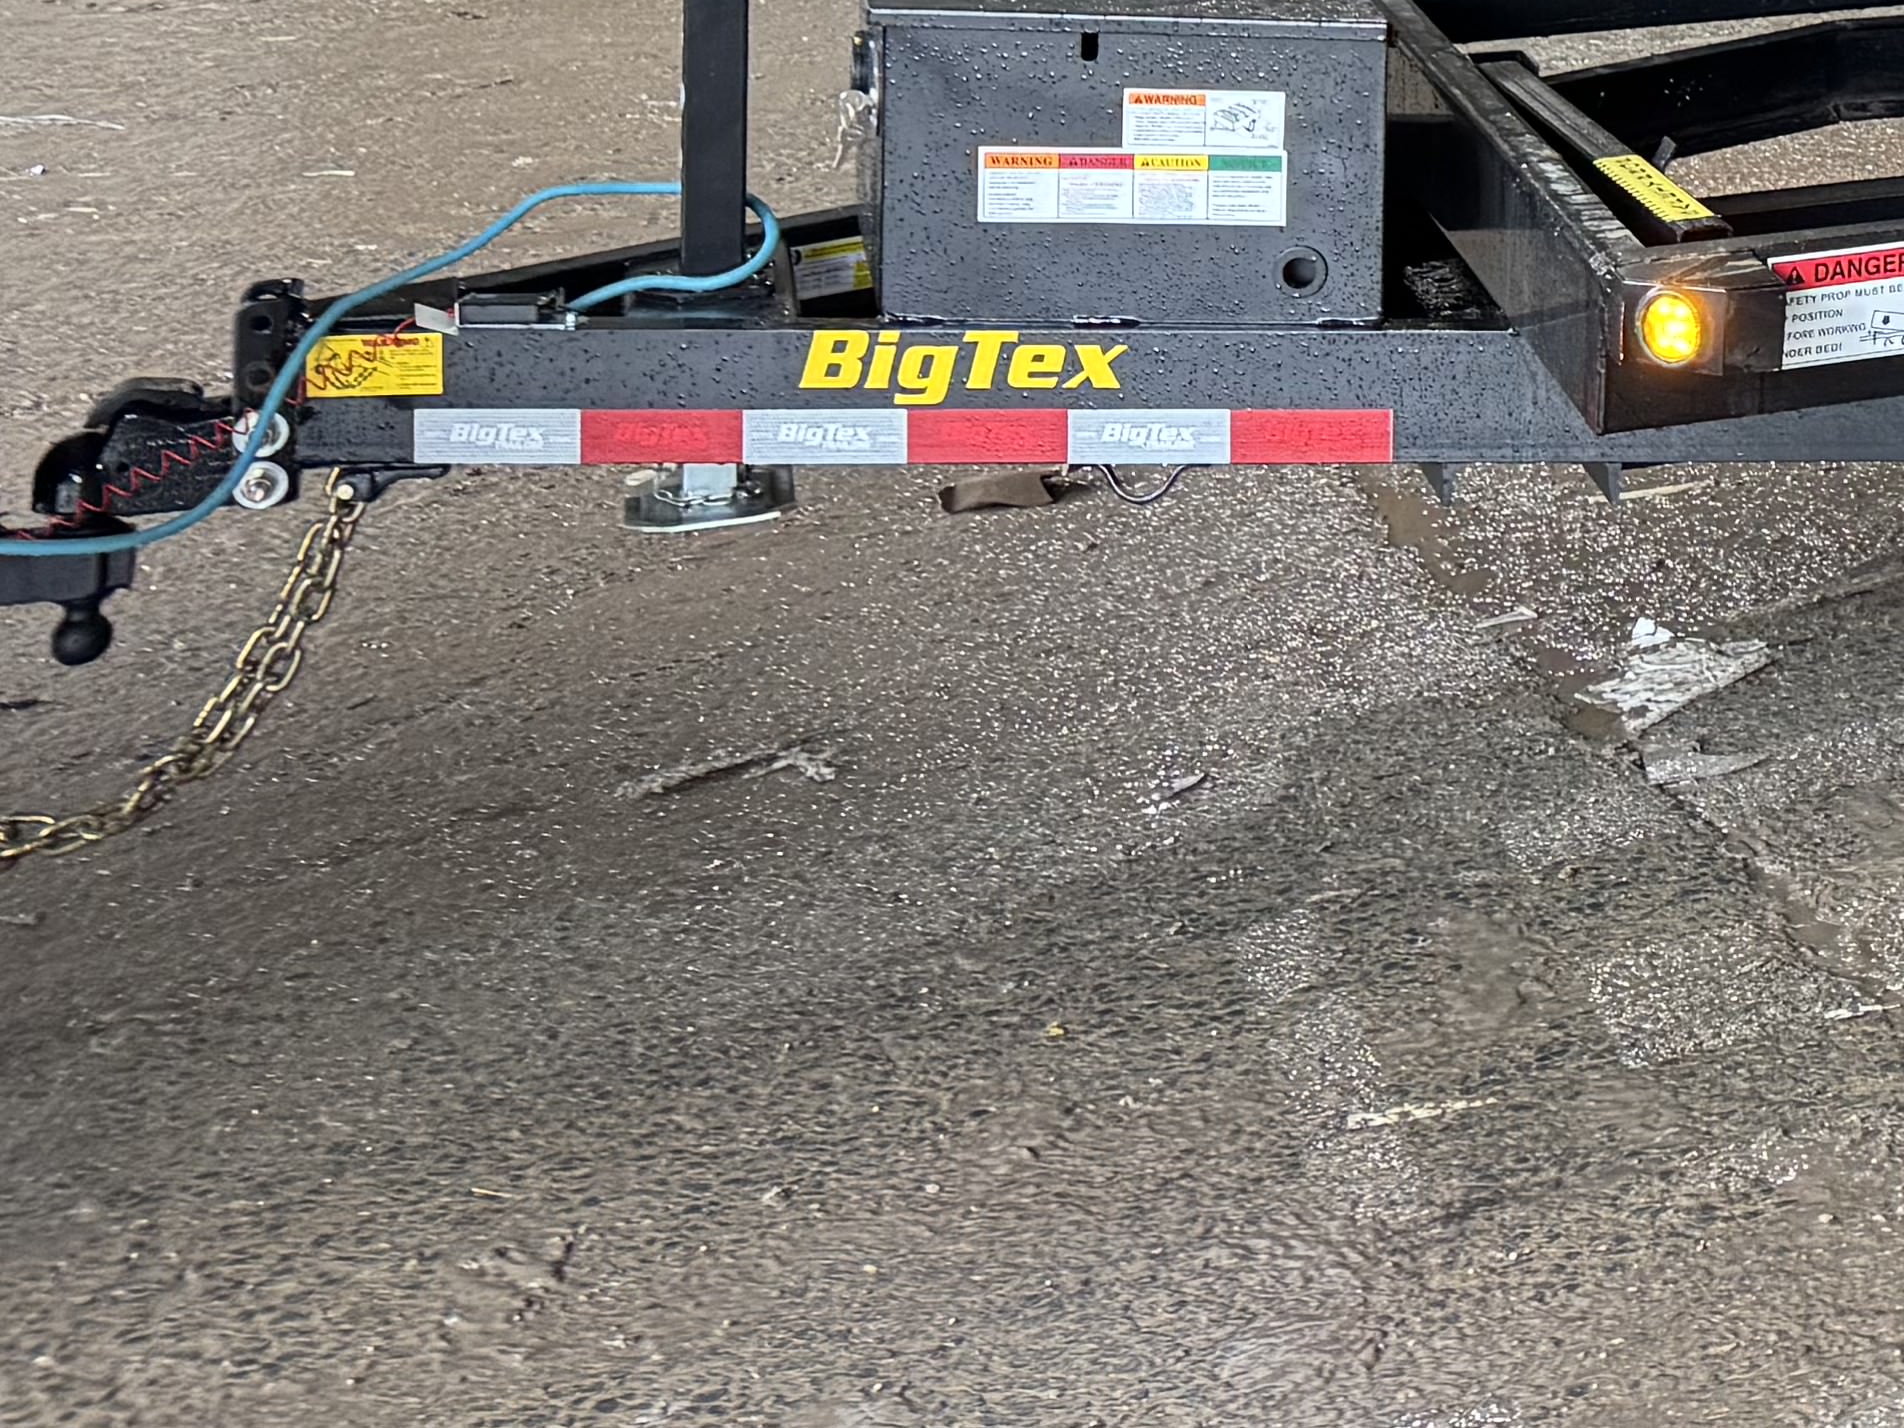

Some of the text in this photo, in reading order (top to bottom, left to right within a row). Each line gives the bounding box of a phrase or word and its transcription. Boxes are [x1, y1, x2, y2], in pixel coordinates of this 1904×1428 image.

[1143, 95, 1198, 105] WARNING
[989, 156, 1052, 166] WARNING
[1150, 157, 1202, 168] CAUTION
[1786, 295, 1817, 307] FETY
[1821, 290, 1851, 302] PROP
[1791, 309, 1844, 323] POSITION
[1786, 329, 1815, 342] FORE
[799, 330, 1129, 405] BigTex
[449, 423, 546, 445] BigTex
[776, 423, 871, 445] BigTex
[1100, 423, 1197, 445] BigTex
